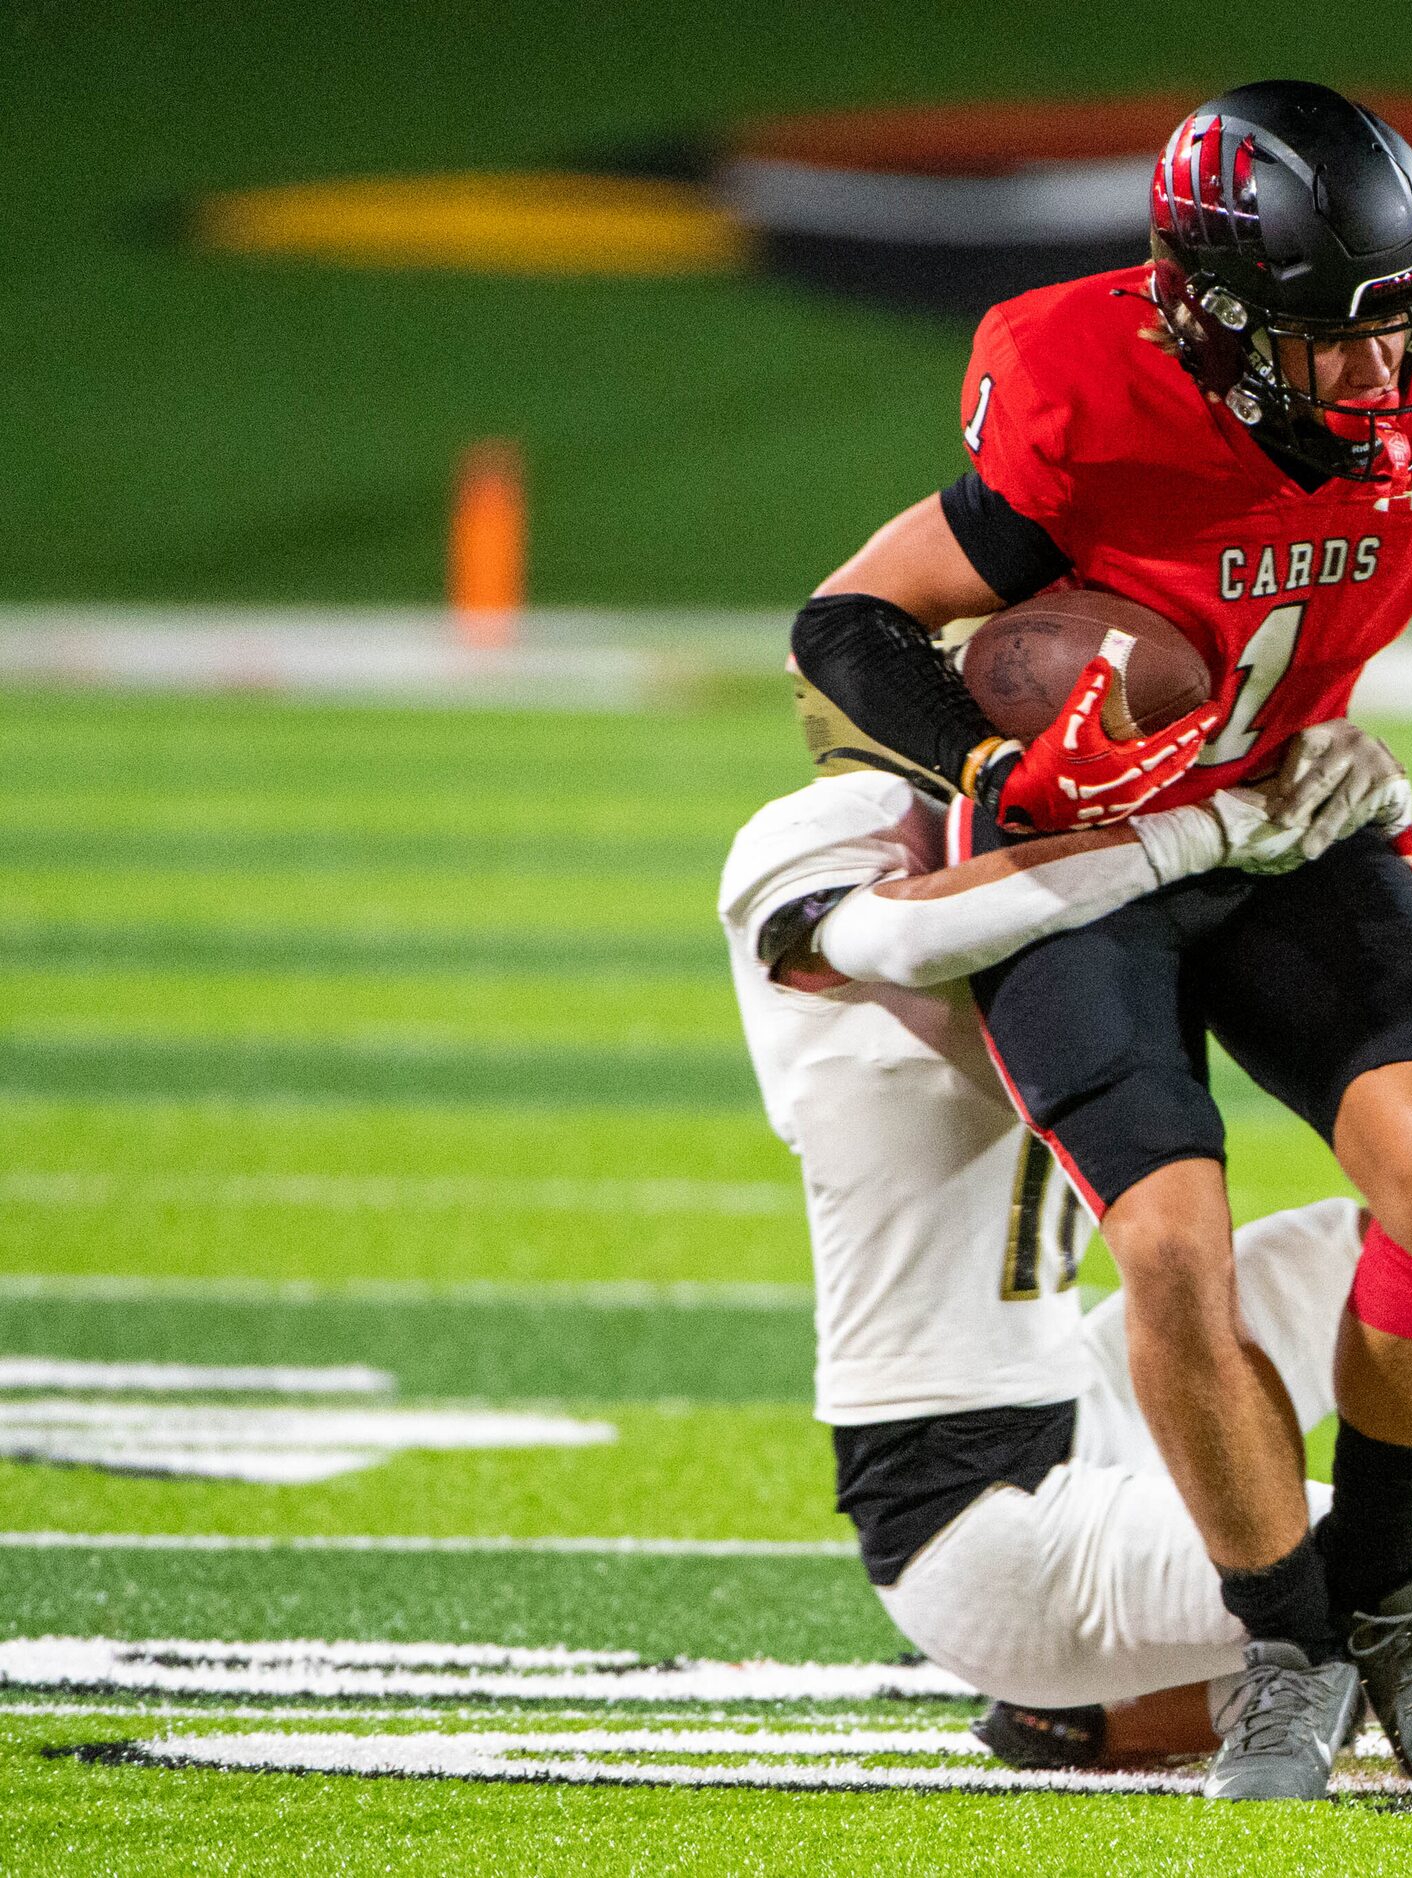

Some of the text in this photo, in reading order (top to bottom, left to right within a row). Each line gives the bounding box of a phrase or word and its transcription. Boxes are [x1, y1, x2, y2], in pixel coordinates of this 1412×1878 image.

[964, 372, 996, 454] 1
[1219, 535, 1381, 600] CARDS
[1193, 599, 1309, 768] 1
